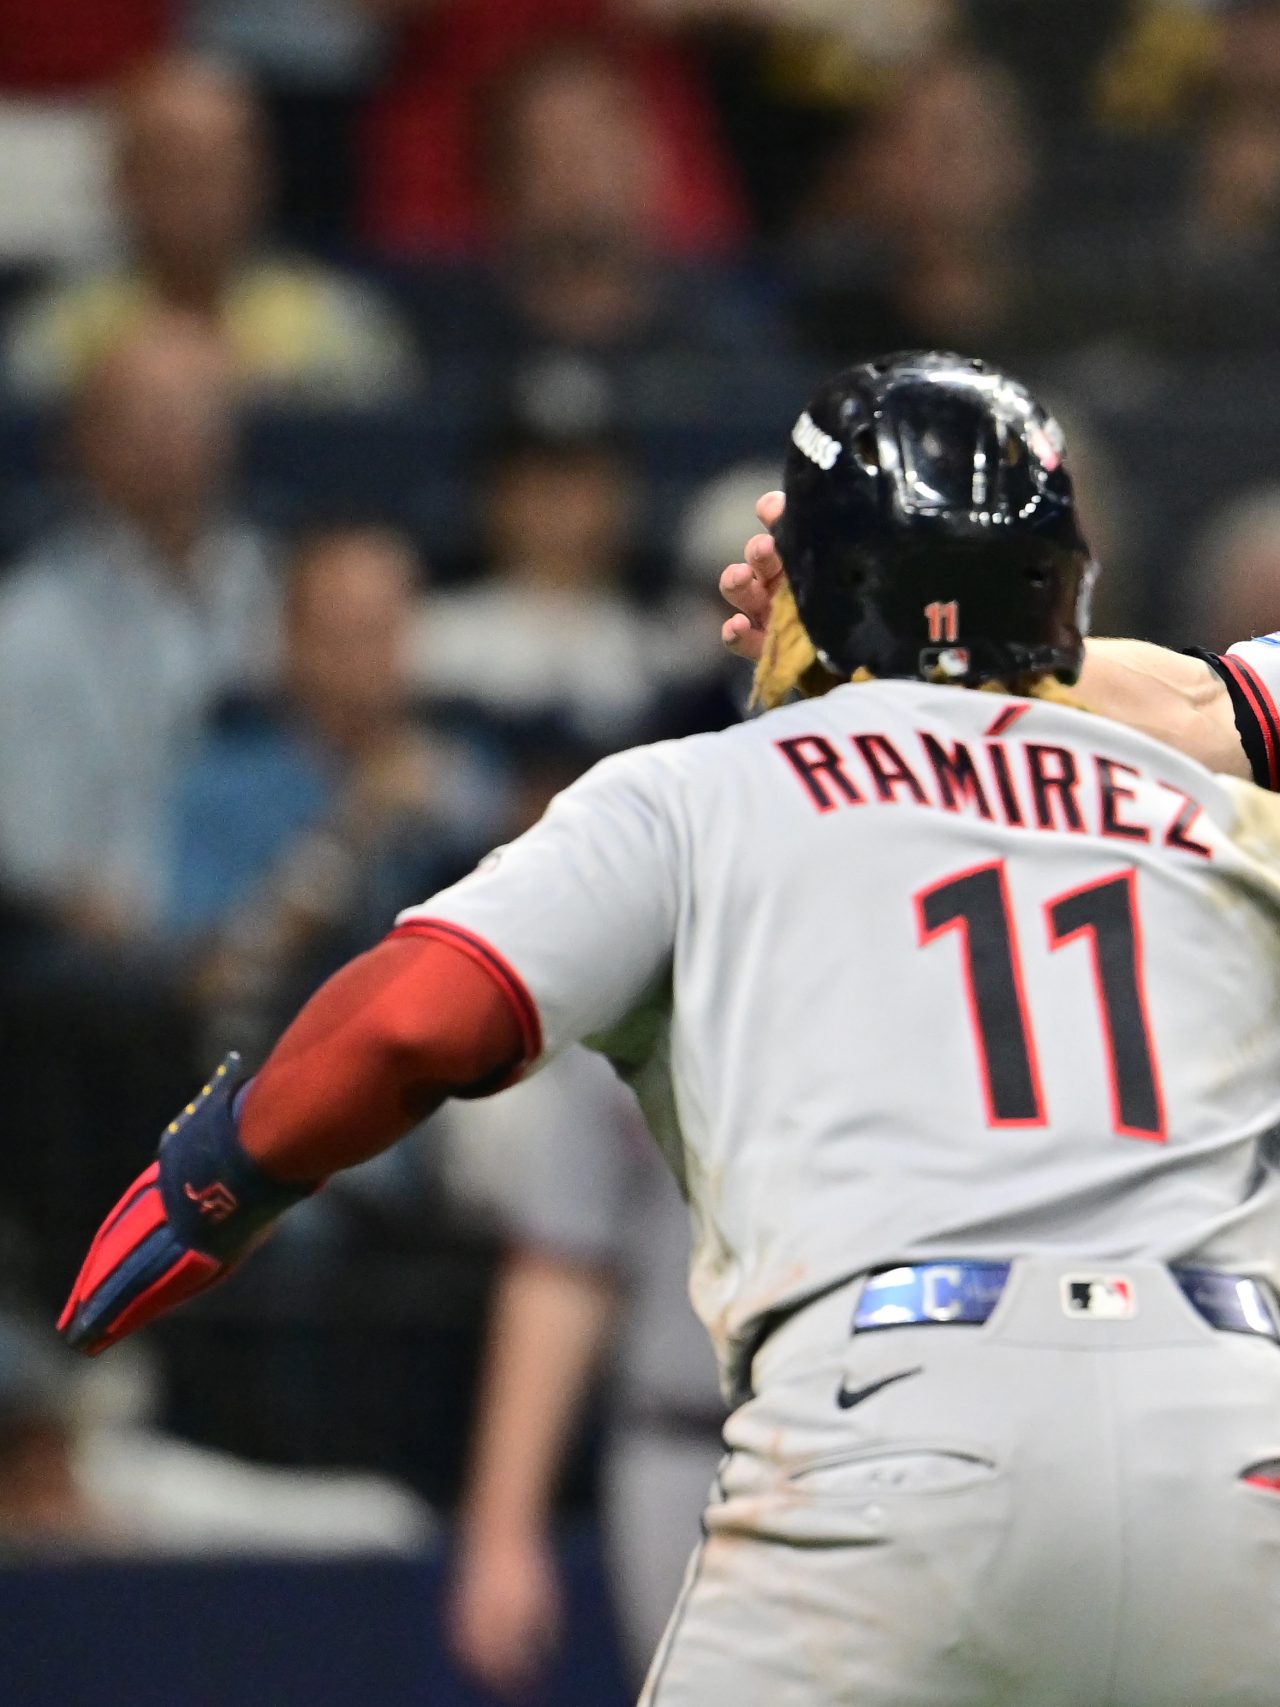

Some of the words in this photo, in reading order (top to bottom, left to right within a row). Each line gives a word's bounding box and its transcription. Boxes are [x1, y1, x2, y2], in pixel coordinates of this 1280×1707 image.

[924, 600, 960, 643] 11
[772, 703, 1214, 860] RAMÍREZ
[911, 857, 1168, 1144] 11
[922, 1266, 961, 1321] C
